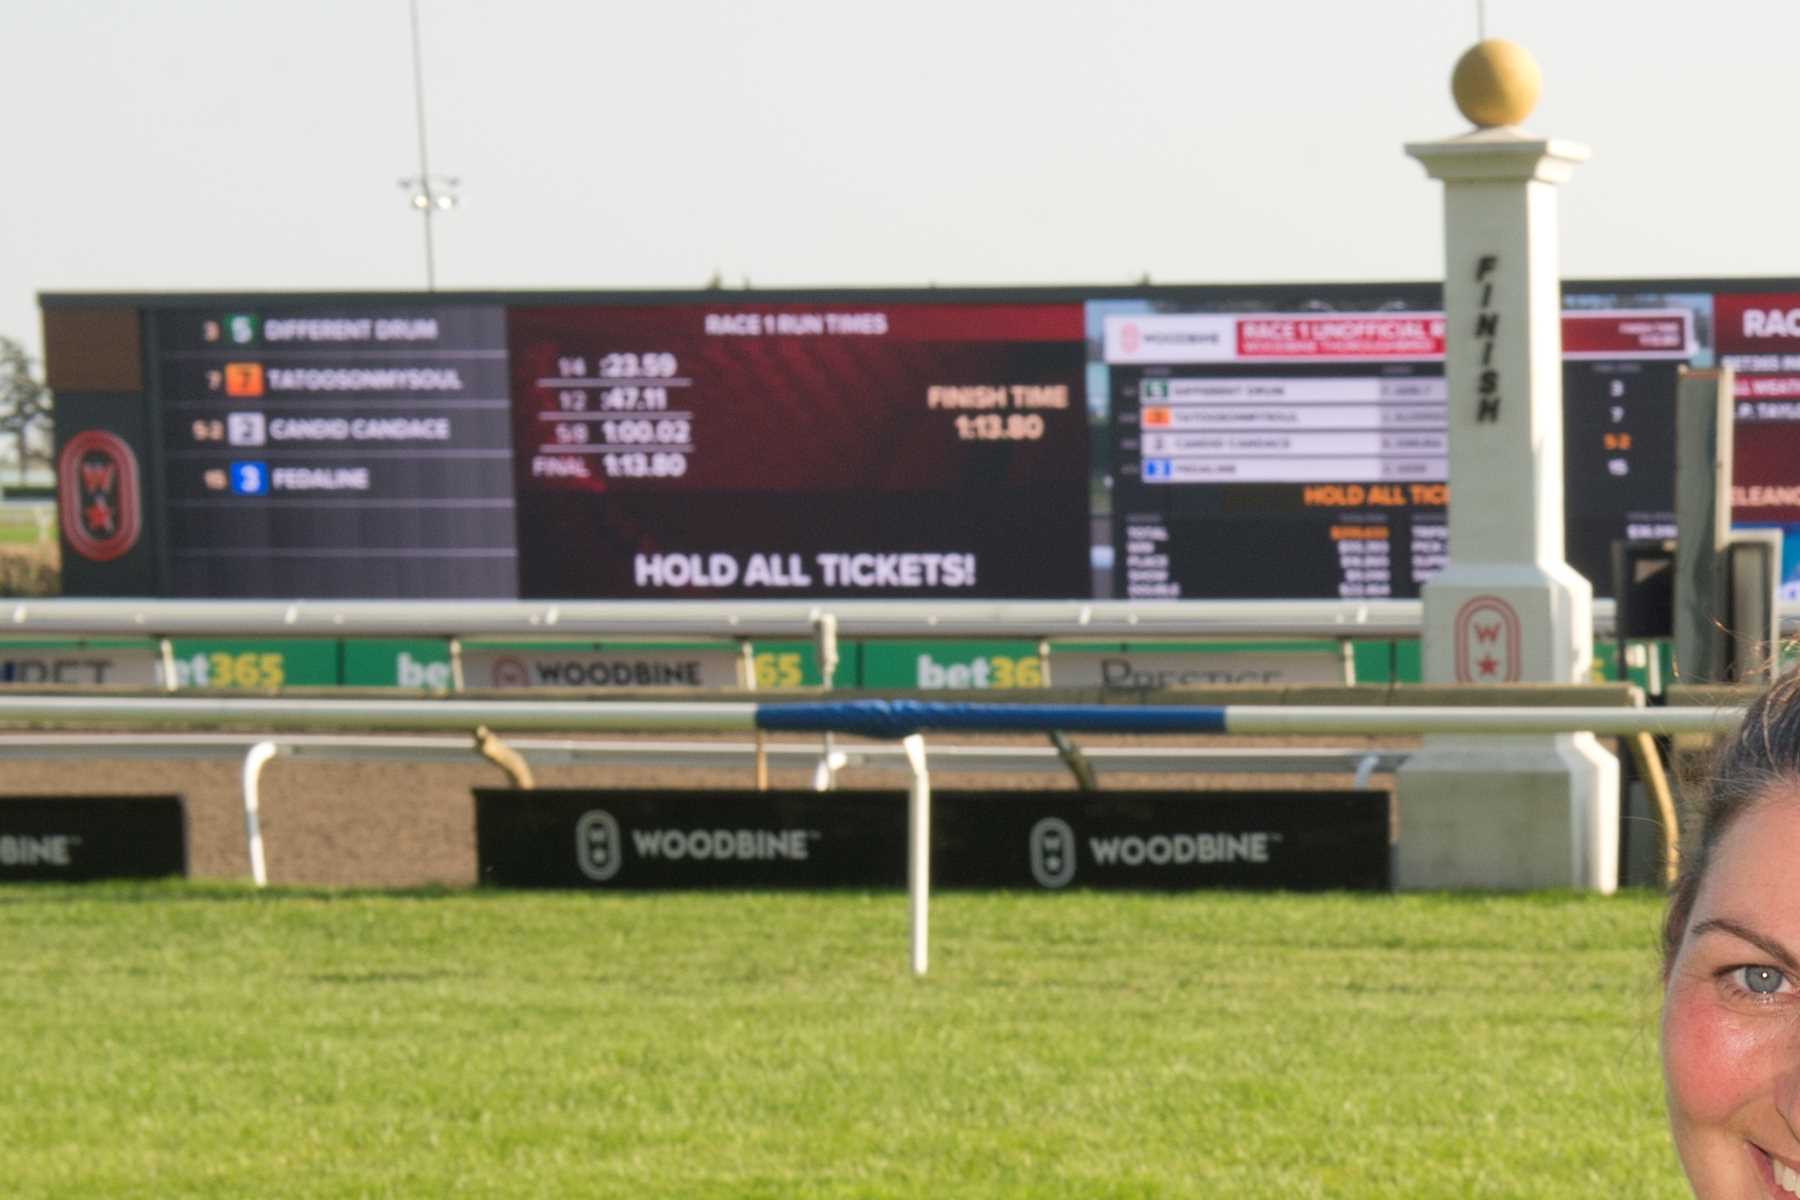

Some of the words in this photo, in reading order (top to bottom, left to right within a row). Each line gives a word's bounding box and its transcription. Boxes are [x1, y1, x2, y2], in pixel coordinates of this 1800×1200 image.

[232, 317, 252, 342] 5
[265, 319, 373, 340] DIFFERENT
[376, 319, 438, 340] DRUM
[706, 314, 761, 335] RACE
[763, 315, 775, 333] 1
[777, 314, 823, 334] RUN
[825, 313, 888, 334] TIMES
[1243, 322, 1294, 338] RACE
[1312, 321, 1424, 337] UNOFFICIAL
[1474, 256, 1501, 423] FINISH
[600, 354, 677, 378] :23.59
[600, 387, 668, 411] :47.11
[928, 386, 1006, 409] FINISH
[1010, 385, 1069, 408] TIME
[352, 418, 450, 440] CANDACE
[602, 419, 692, 444] 1:00.02
[956, 415, 1044, 440] 1:13.80
[532, 457, 590, 477] FINAL
[603, 453, 686, 477] 1:13.80
[240, 465, 261, 492] 3
[1304, 484, 1364, 505] HOLD
[1367, 484, 1405, 504] ALL
[635, 554, 738, 587] HOLD
[744, 553, 811, 586] ALL
[817, 553, 976, 586] TICKETS!
[537, 662, 700, 686] WOODBINE
[633, 829, 809, 860] WOODBINE
[1089, 832, 1268, 866] WOODBINE
